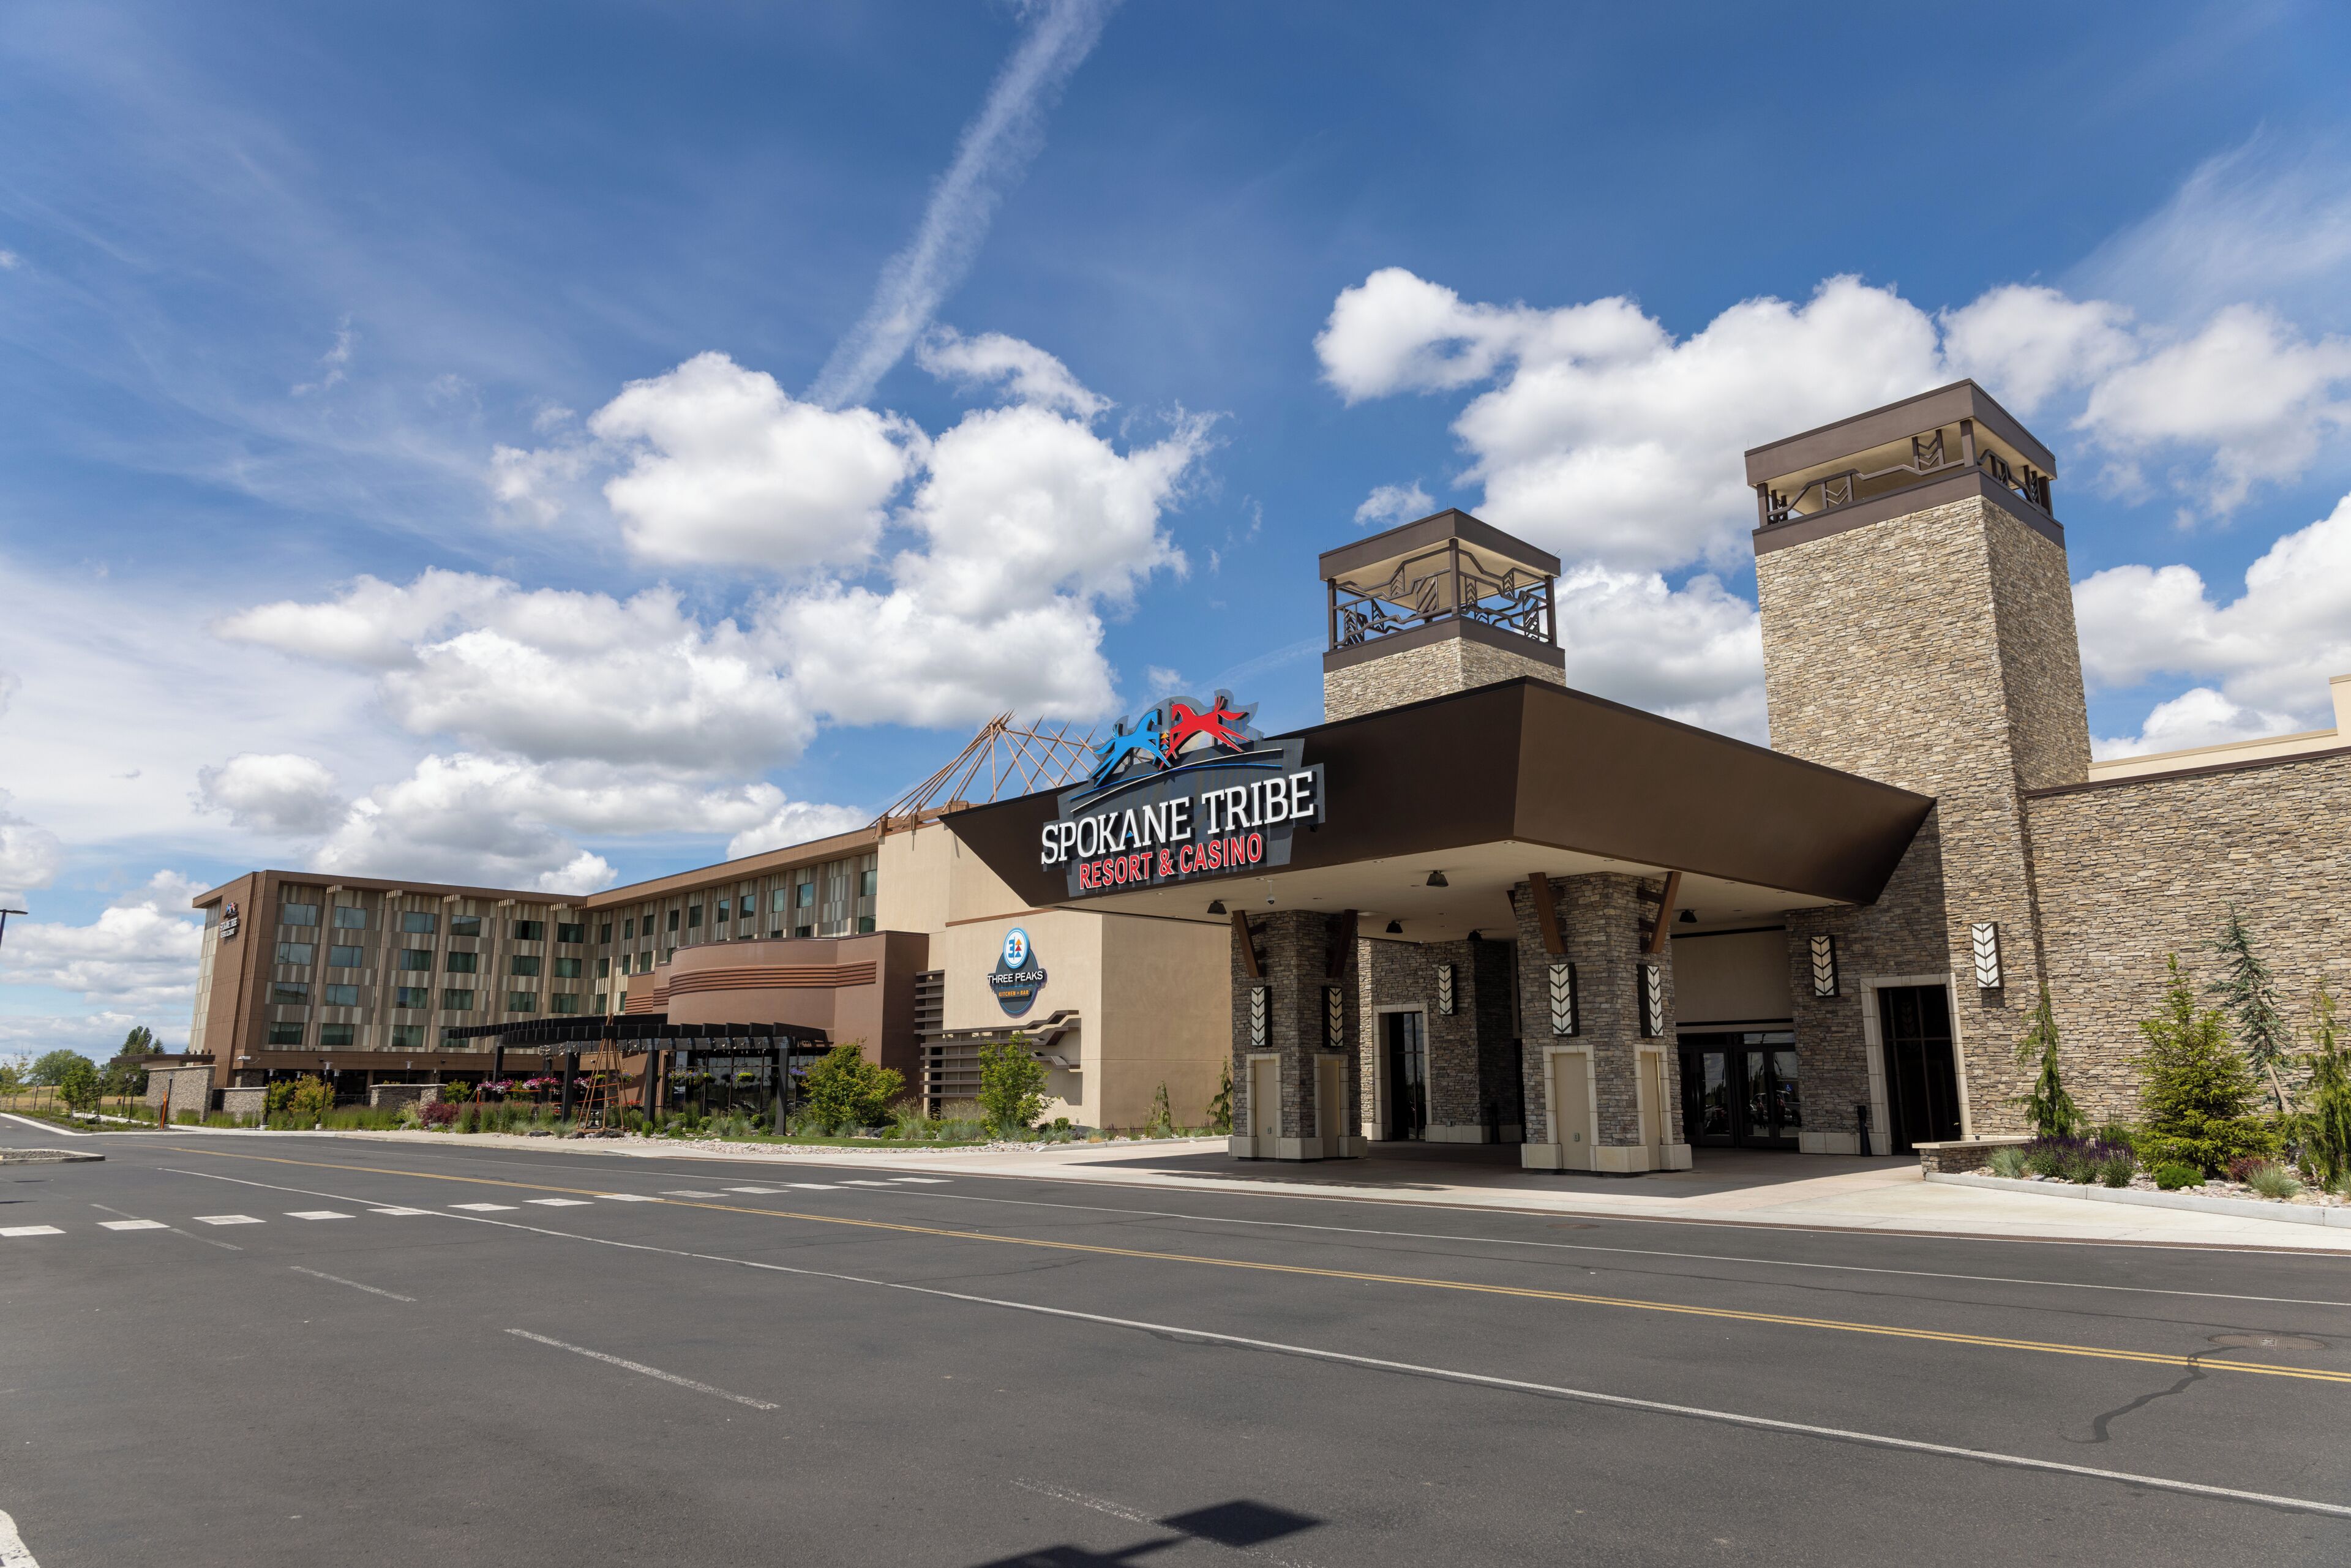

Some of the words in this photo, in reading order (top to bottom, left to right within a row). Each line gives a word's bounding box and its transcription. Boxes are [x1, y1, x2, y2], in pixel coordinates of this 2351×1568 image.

[1041, 797, 1193, 865] SPOKANE
[1201, 771, 1315, 835] TRIBE
[1079, 852, 1152, 890] RESORT
[1159, 848, 1173, 877] &
[1179, 833, 1262, 873] CASINO
[988, 973, 1013, 984] THREE
[1015, 971, 1043, 981] PEAKS
